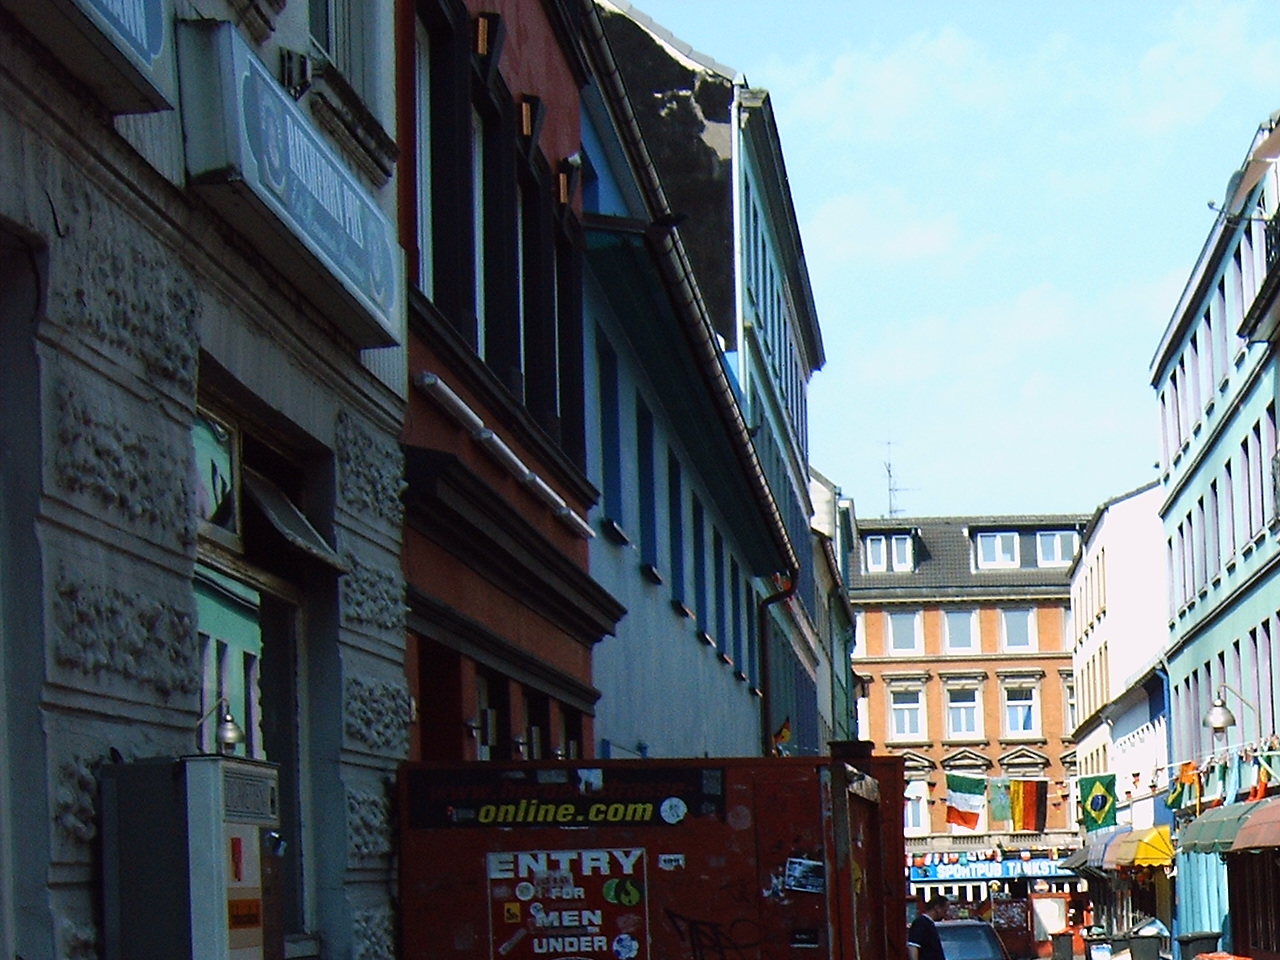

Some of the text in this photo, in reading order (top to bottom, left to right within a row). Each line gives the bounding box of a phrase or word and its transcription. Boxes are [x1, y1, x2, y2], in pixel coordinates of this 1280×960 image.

[478, 799, 654, 824] online.com
[488, 850, 643, 879] ENTRY
[936, 862, 1000, 878] SPORTPUB
[552, 887, 585, 899] FOR
[536, 910, 602, 927] MEN
[533, 936, 607, 954] UNDER
